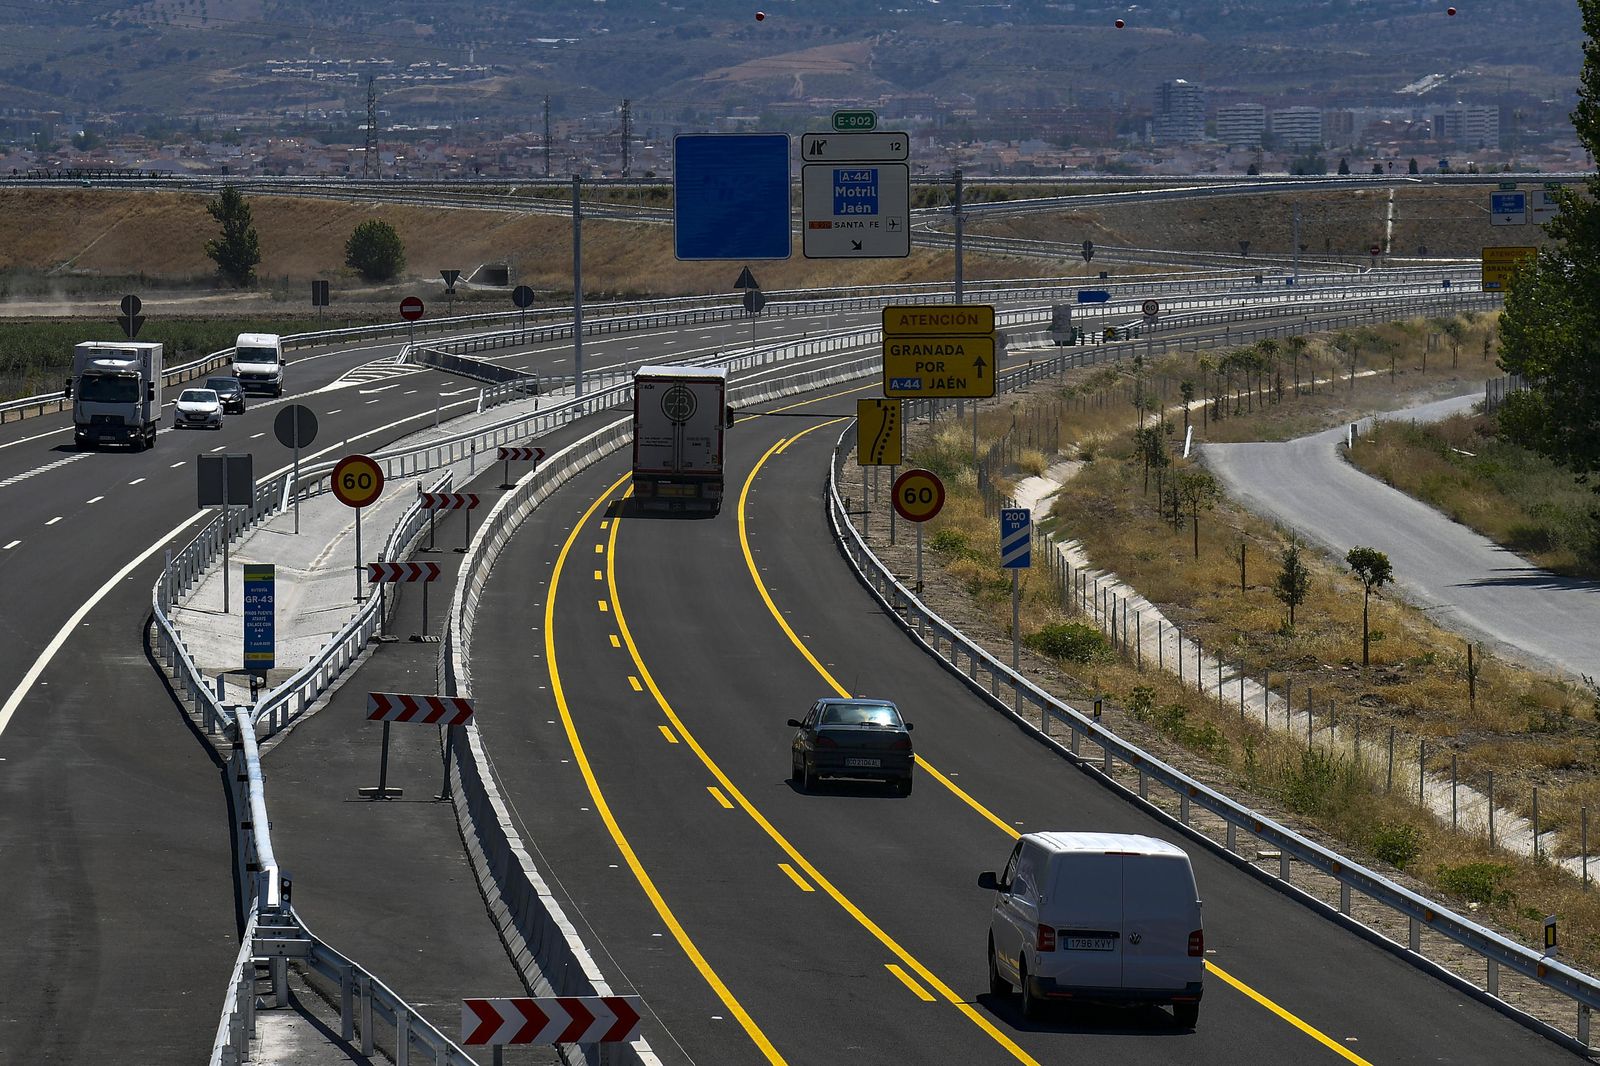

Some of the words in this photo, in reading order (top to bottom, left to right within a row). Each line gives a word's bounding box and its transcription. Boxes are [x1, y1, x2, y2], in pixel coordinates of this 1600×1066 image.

[837, 116, 871, 126] E-902
[889, 142, 901, 151] 12
[842, 172, 869, 181] A-44
[835, 186, 876, 197] Motril
[840, 202, 871, 213] Jaén
[834, 221, 864, 229] SANTA
[899, 311, 978, 326] ATENCIÓN
[890, 344, 965, 356] GRANADA
[915, 361, 945, 373] POR
[891, 379, 921, 389] A-44
[928, 375, 967, 389] JAÉN
[343, 472, 372, 490] 60
[904, 487, 933, 504] 60
[1005, 512, 1026, 521] 200
[245, 595, 273, 603] GR-43
[1071, 939, 1092, 948] 1796
